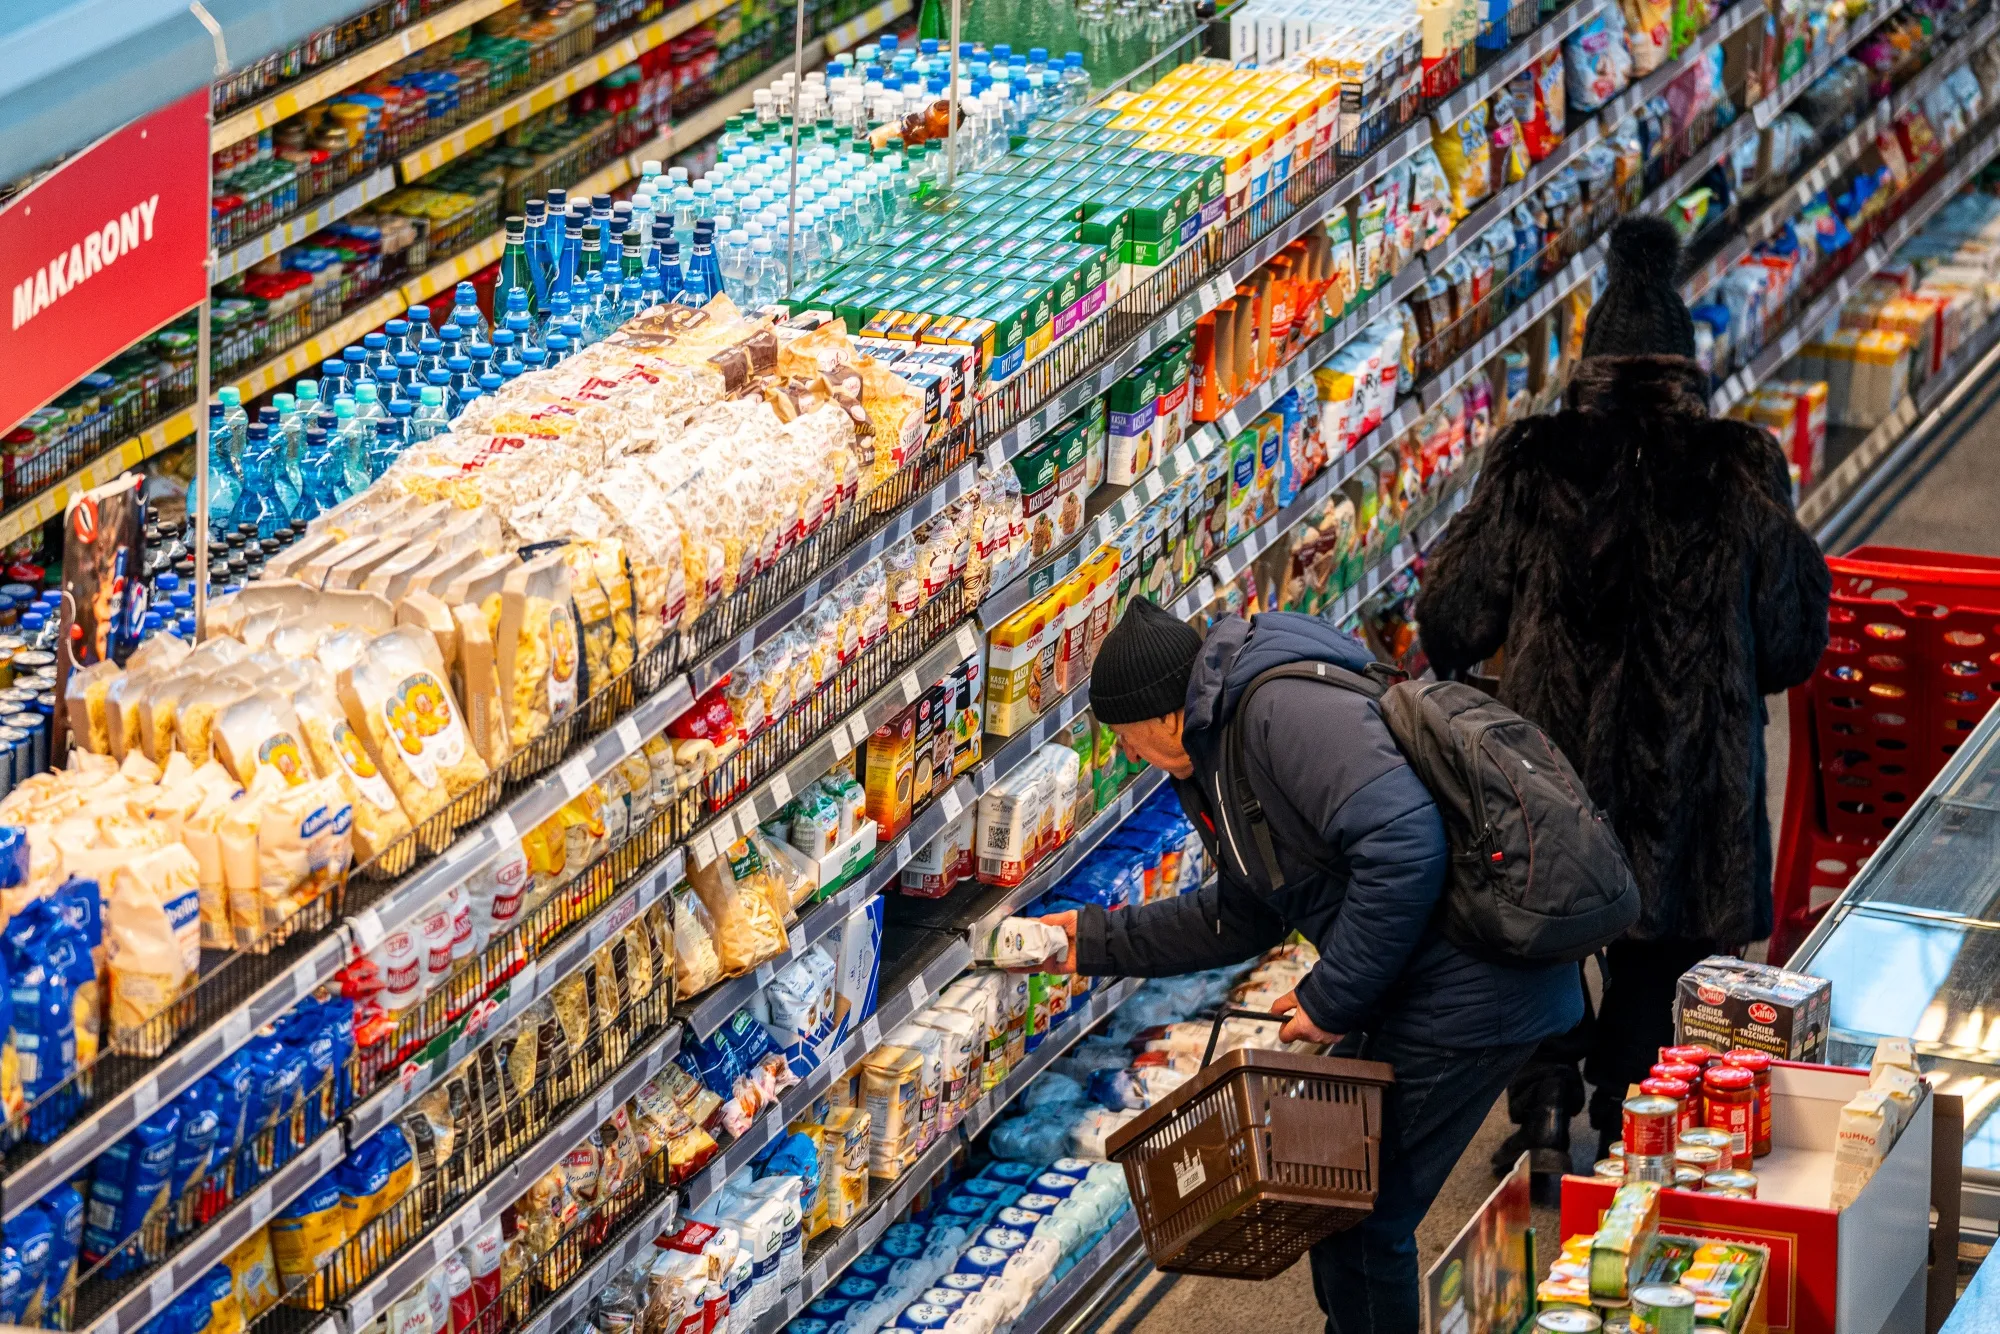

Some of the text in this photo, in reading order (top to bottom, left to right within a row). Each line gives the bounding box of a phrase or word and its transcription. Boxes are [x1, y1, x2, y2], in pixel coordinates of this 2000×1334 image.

[12, 194, 160, 331] MAKARONY
[1112, 416, 1126, 425] KASZA
[1026, 634, 1044, 652] SONKO
[990, 675, 1009, 686] KASZA
[1697, 1004, 1723, 1018] CUKIER
[1740, 1029, 1781, 1045] TRZCINOWY
[1748, 1023, 1774, 1036] CUKIER
[1734, 1036, 1785, 1053] NIERAFINOWANY
[1839, 1131, 1877, 1146] RUMMO
